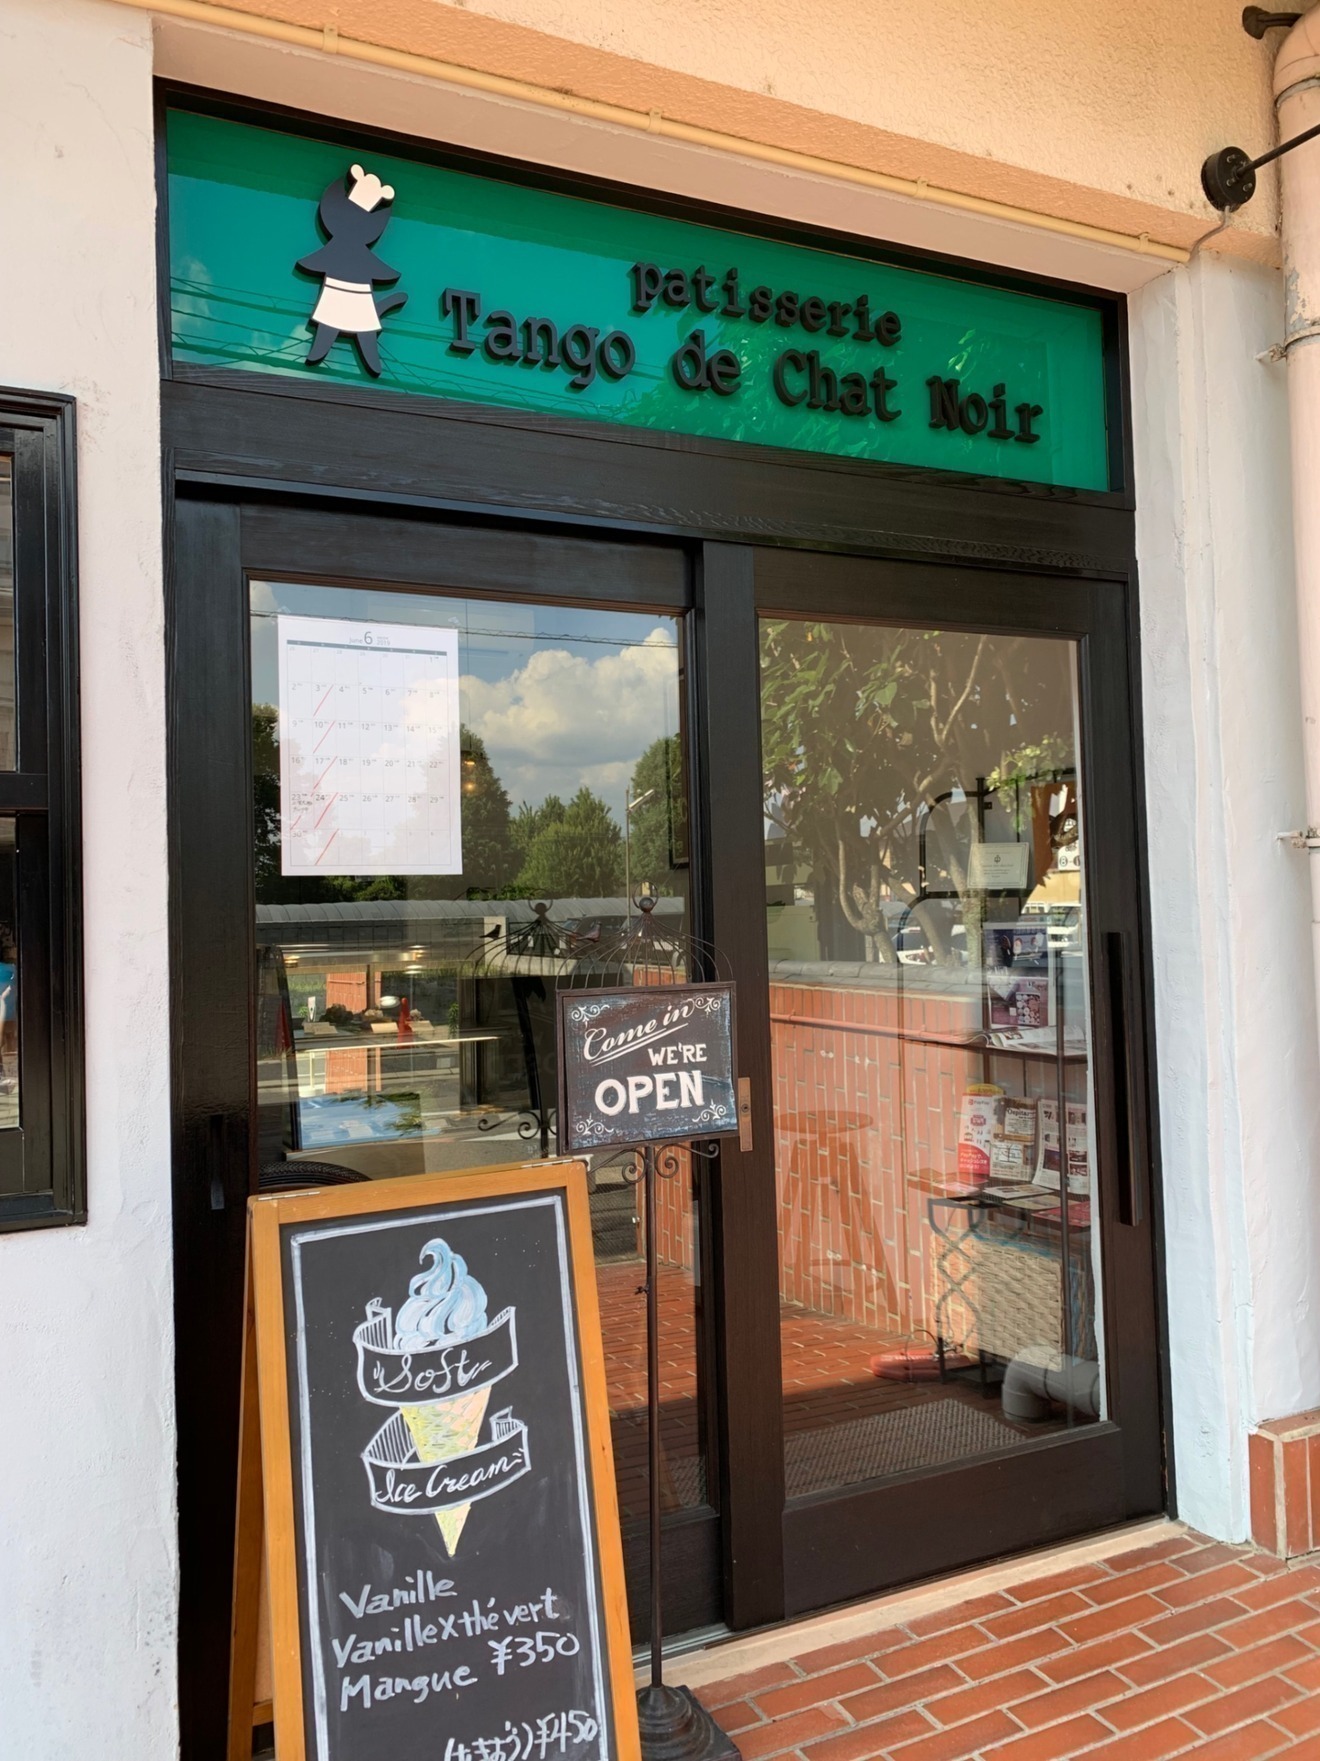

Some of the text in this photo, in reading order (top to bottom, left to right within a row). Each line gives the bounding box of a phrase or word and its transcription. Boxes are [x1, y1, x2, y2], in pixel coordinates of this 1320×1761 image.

[633, 262, 901, 346] patisserie
[442, 288, 1044, 444] Tango de Chat Noir
[364, 631, 373, 645] 6
[583, 998, 695, 1061] Come in
[647, 1042, 708, 1067] WE'RE
[594, 1069, 705, 1117] OPEN
[375, 1455, 516, 1503] Ice Cream
[339, 1569, 458, 1619] Vanille
[503, 1587, 560, 1626] vert
[487, 1630, 580, 1676] ¥350
[340, 1665, 478, 1712] Mangue
